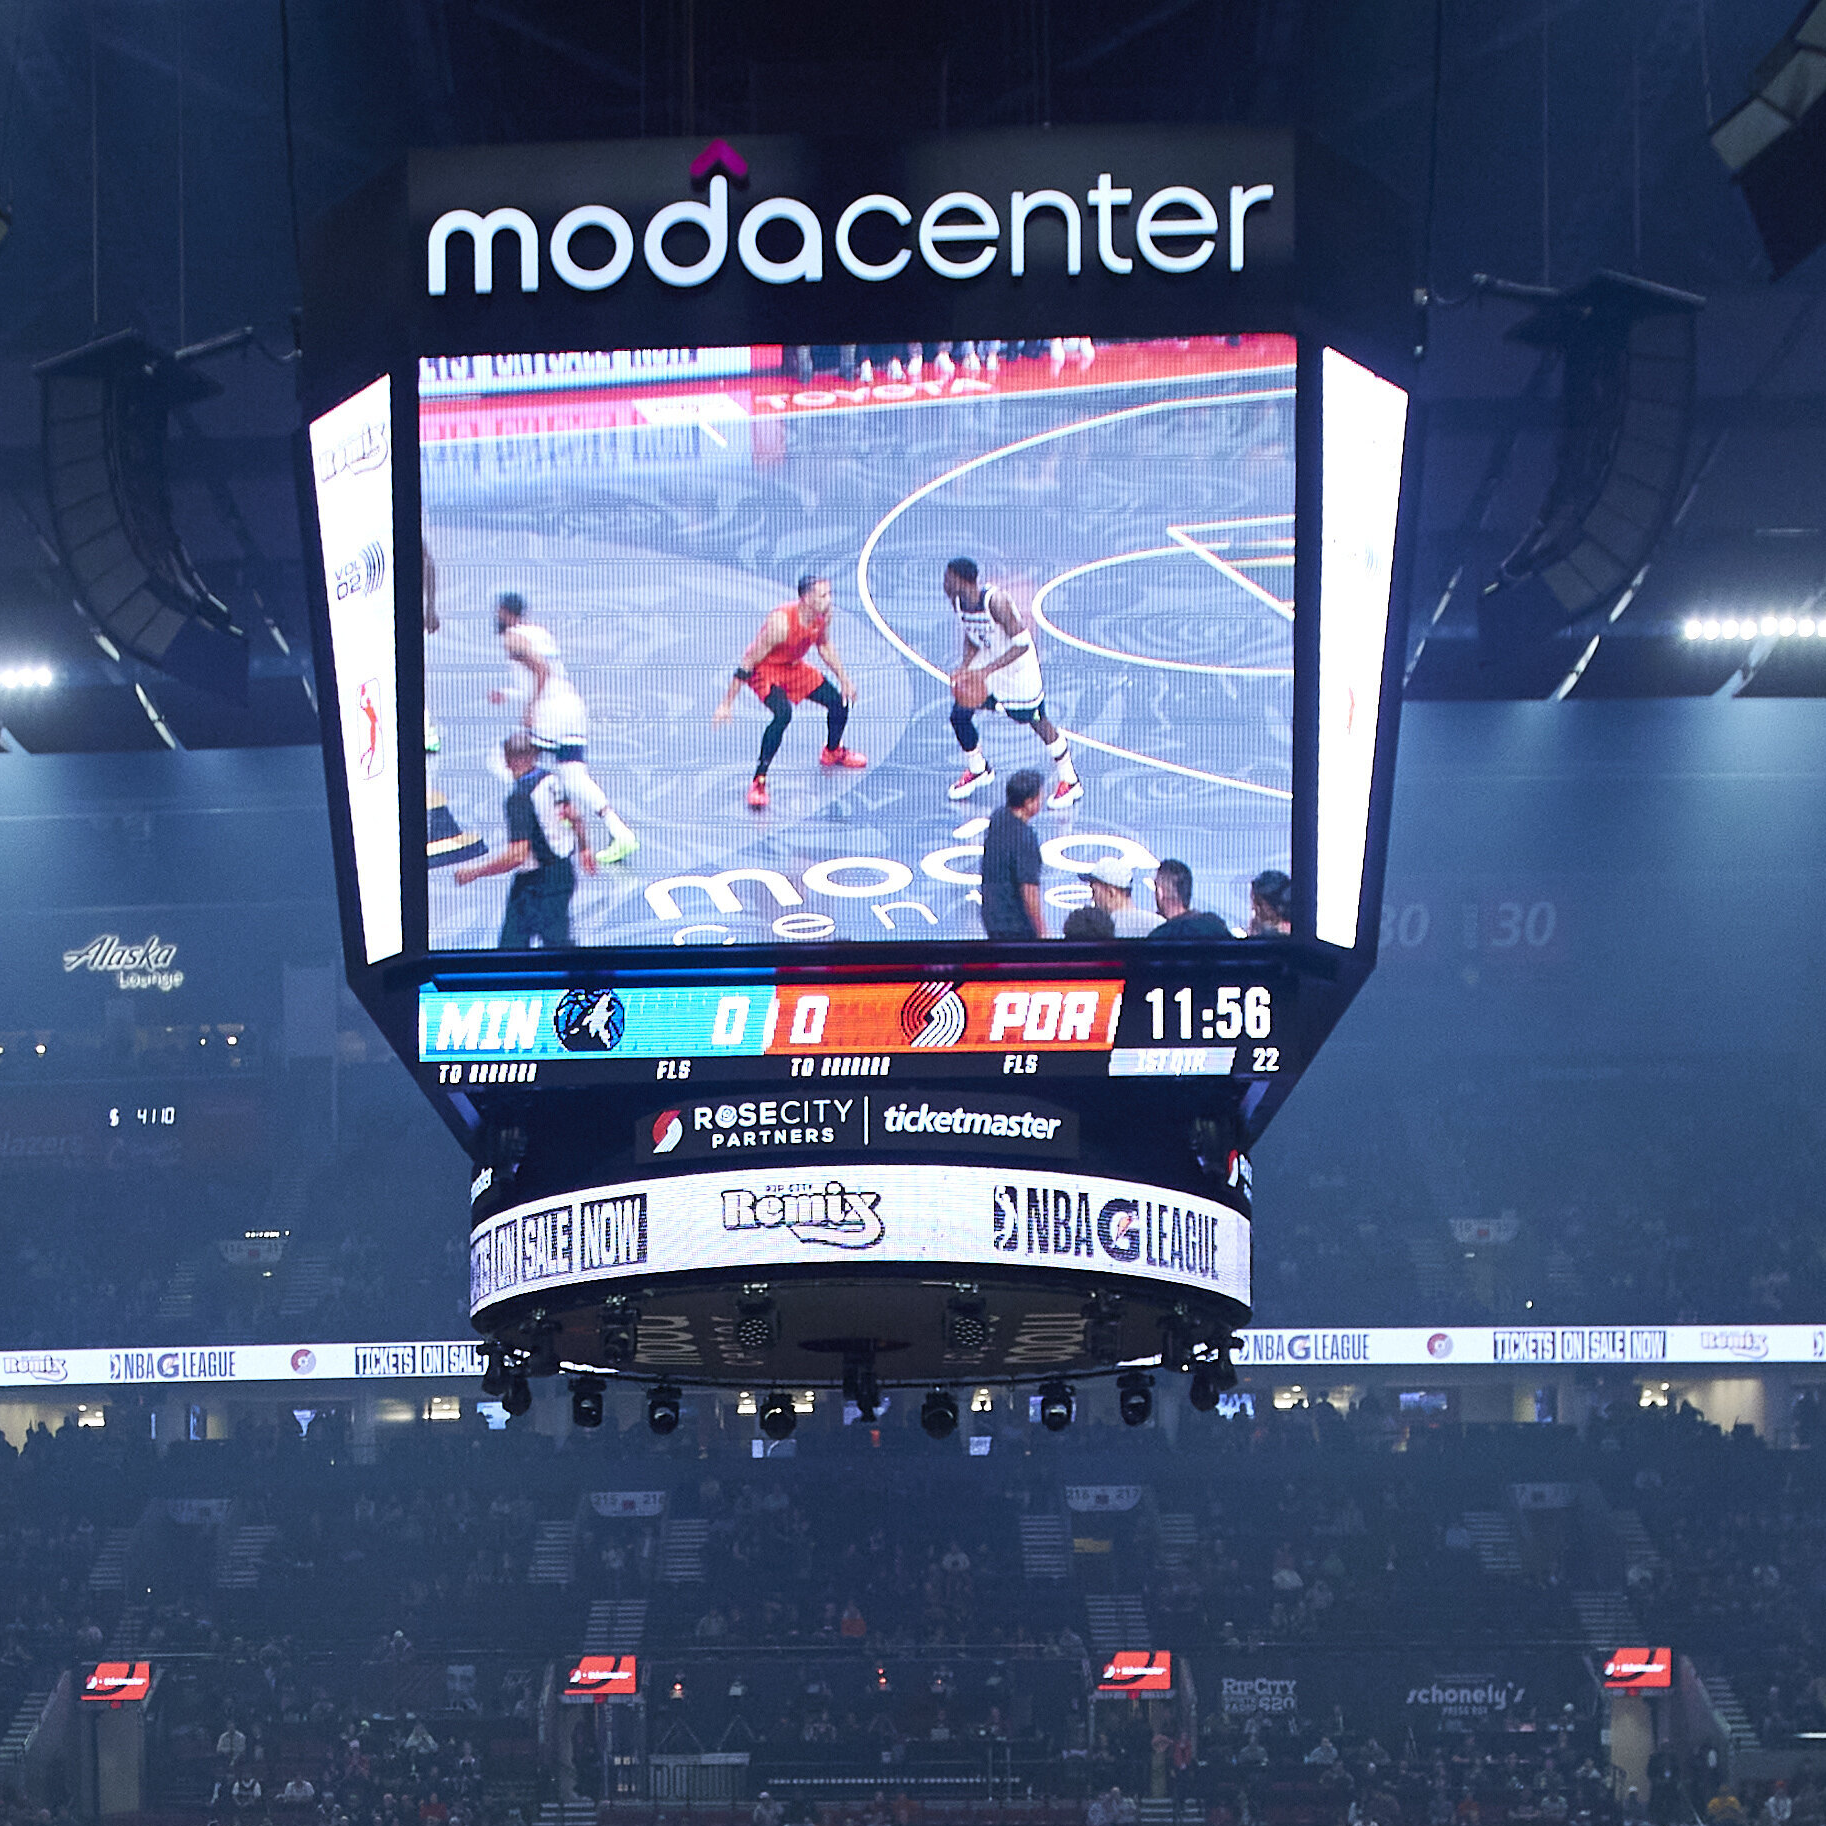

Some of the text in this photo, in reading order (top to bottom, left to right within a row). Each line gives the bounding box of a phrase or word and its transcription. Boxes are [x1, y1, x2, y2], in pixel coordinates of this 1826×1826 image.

[63, 935, 178, 972] Alaska
[119, 971, 184, 992] Lounge
[436, 1000, 542, 1050] MIN
[711, 997, 830, 1045] 0 0
[989, 991, 1100, 1041] POR
[1145, 987, 1272, 1040] 11:56
[656, 1060, 692, 1080] FLS
[1003, 1054, 1039, 1074] FLS
[1252, 1056, 1280, 1081] 22
[711, 1127, 835, 1149] PARTNERS
[884, 1103, 1063, 1140] ticketmaster
[720, 1180, 891, 1250] Remix
[523, 1204, 573, 1281] SALE
[580, 1192, 648, 1270] NOW
[1027, 1186, 1220, 1281] NBA G LEAGUE
[355, 1346, 416, 1375] TICKETS
[421, 1345, 444, 1374] ON
[1253, 1334, 1370, 1361] NBA G LEAGUE
[1493, 1331, 1666, 1361] TICKETS ON SALE NOW
[124, 1351, 236, 1379] NBA G LEAGUE
